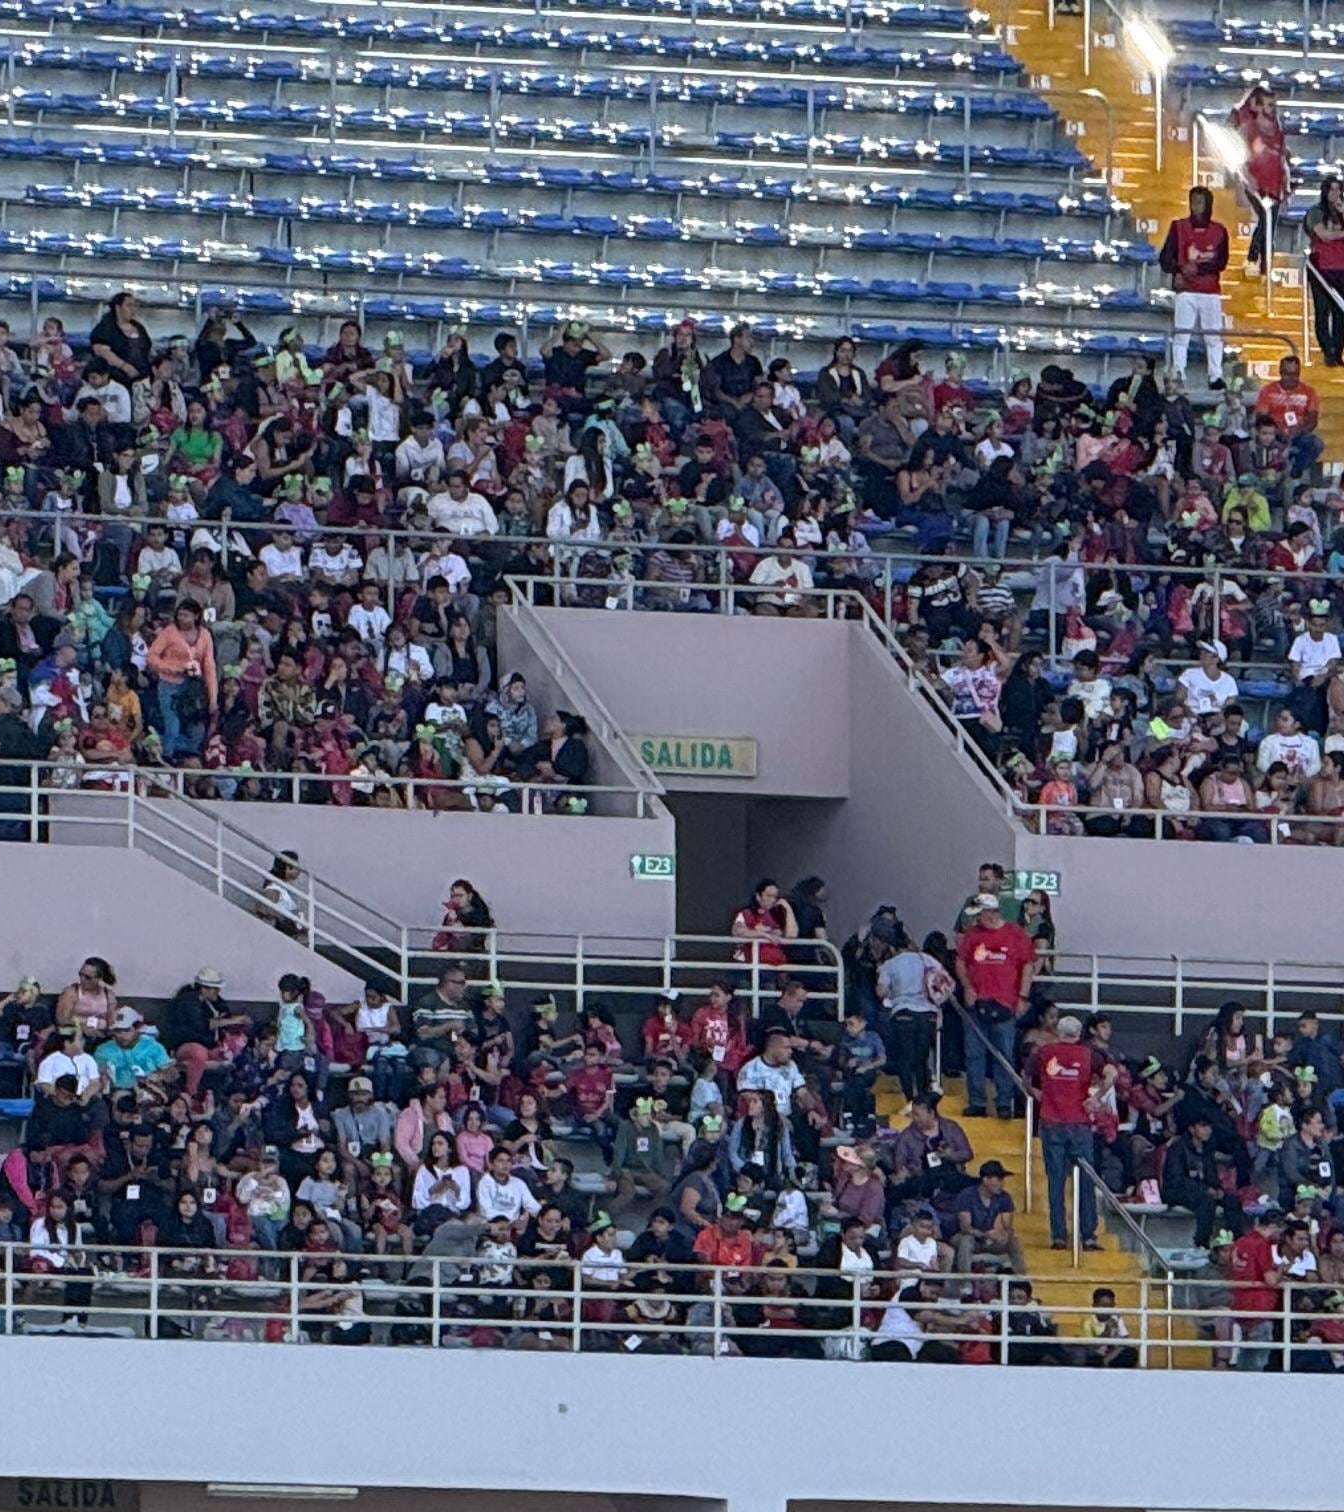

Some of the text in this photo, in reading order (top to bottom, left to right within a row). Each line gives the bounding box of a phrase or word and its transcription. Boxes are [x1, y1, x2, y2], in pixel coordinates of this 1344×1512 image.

[640, 740, 733, 769] SALIDA
[645, 856, 672, 873] E23
[1031, 871, 1058, 889] E23
[17, 1480, 116, 1508] SALIDA
